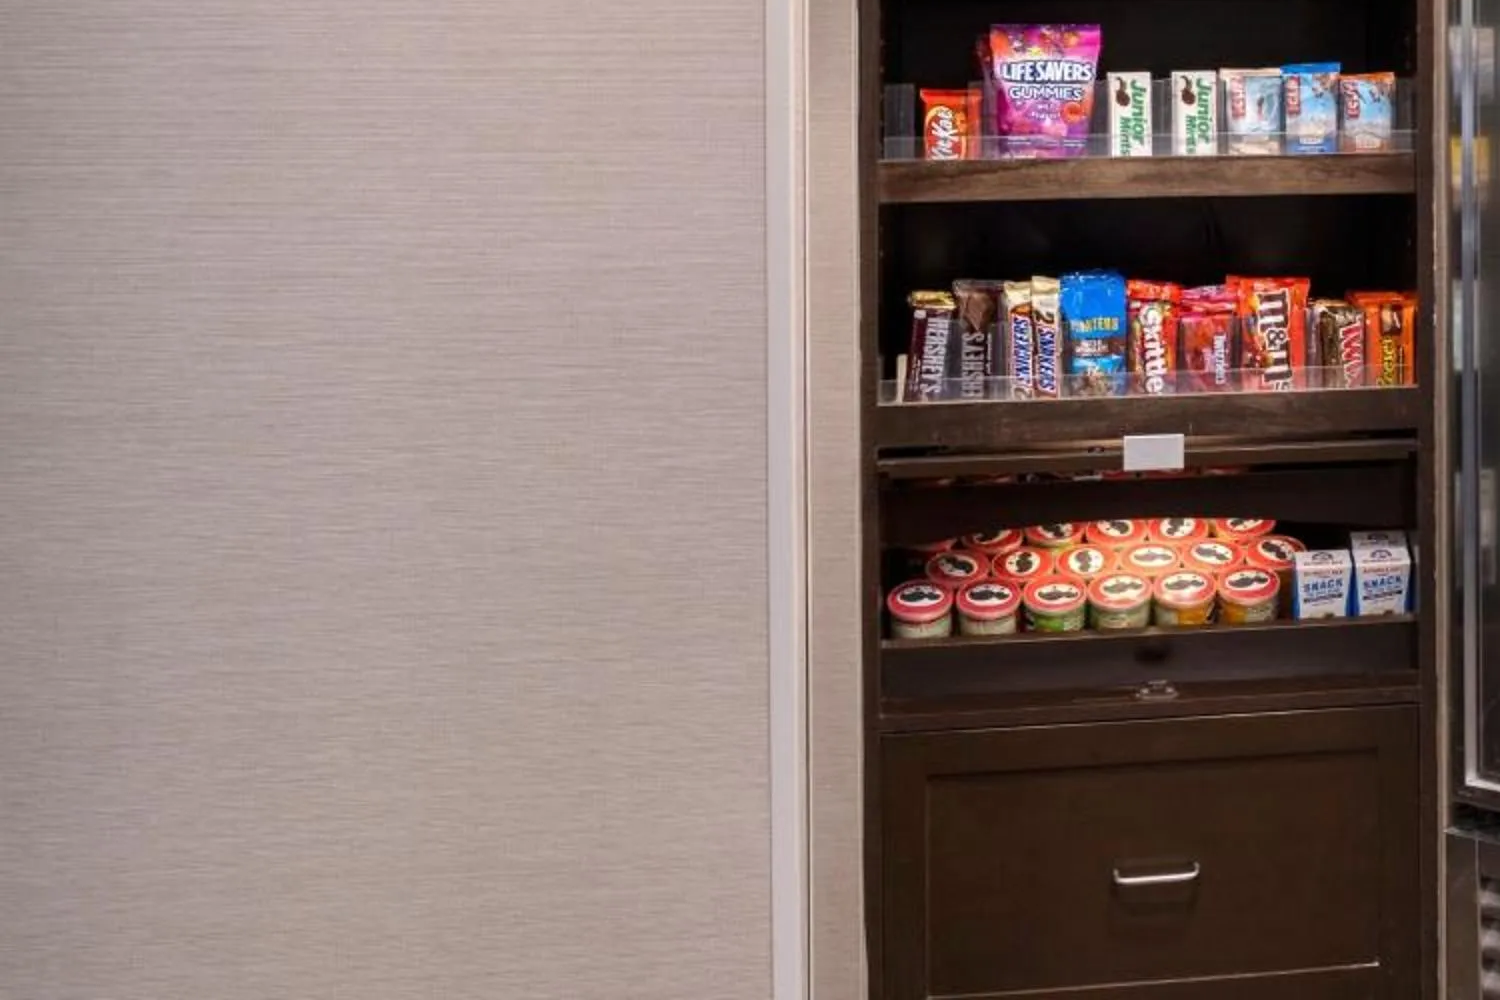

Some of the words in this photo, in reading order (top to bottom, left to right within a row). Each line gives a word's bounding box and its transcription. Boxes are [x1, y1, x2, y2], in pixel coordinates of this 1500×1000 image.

[1009, 86, 1083, 101] GUMMIES
[1130, 79, 1147, 145] Junior
[1196, 78, 1212, 144] Junior
[920, 317, 949, 394] HERSHEY'S
[961, 331, 985, 397] ERSHEY'S
